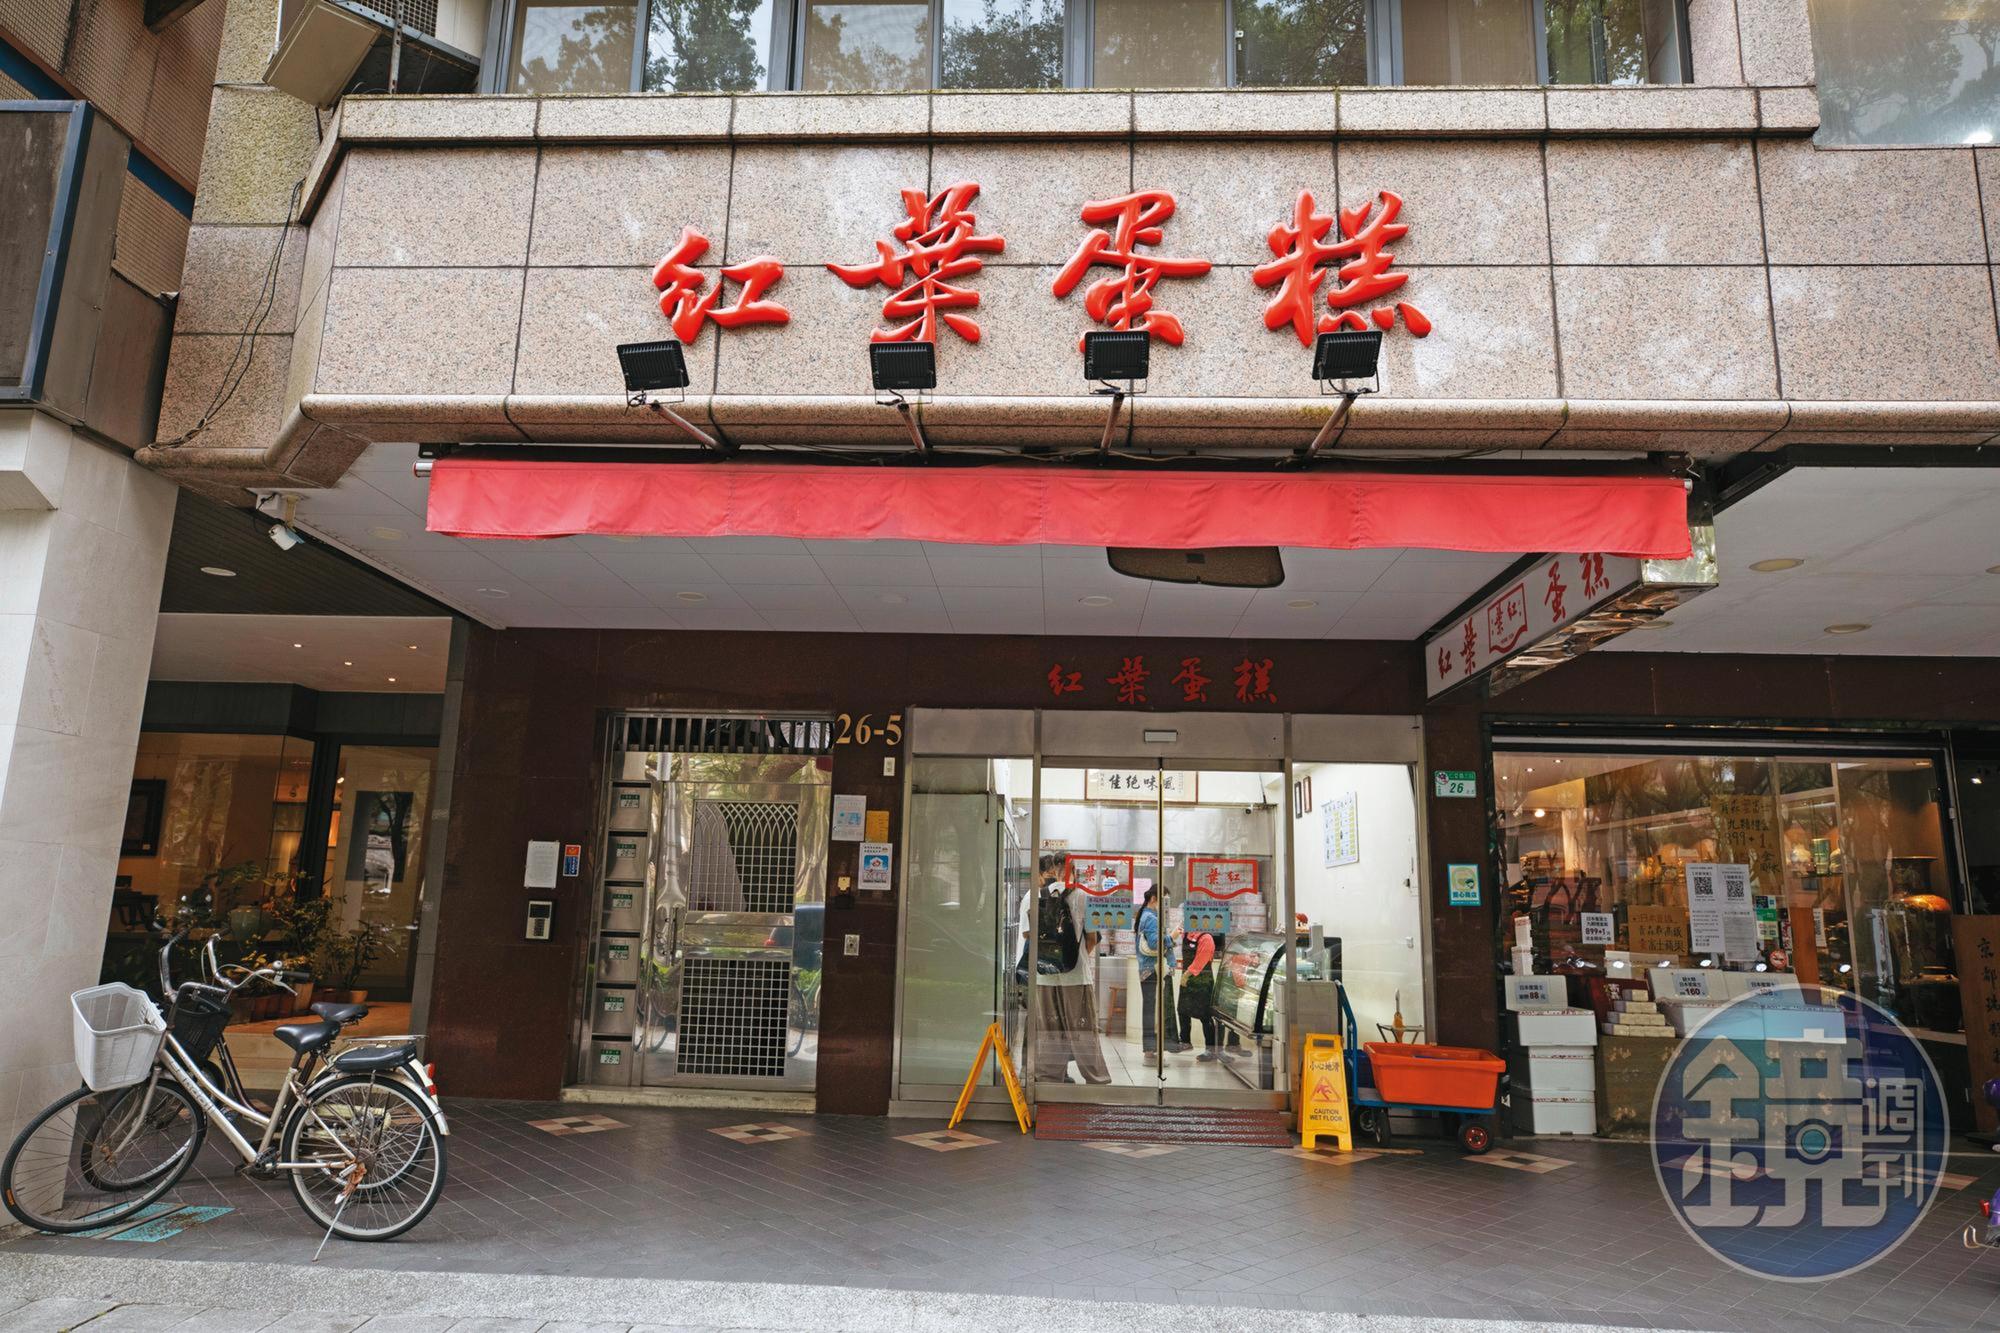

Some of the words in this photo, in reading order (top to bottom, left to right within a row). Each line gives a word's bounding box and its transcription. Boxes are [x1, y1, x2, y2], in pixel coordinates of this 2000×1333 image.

[651, 182, 1434, 350] 紅葉蛋糕
[1048, 655, 1278, 705] 紅葉蛋糕
[835, 713, 903, 746] 26-5
[1449, 782, 1464, 794] 26
[1309, 1061, 1340, 1072] 小心地滑
[1313, 1107, 1340, 1116] CAUTION
